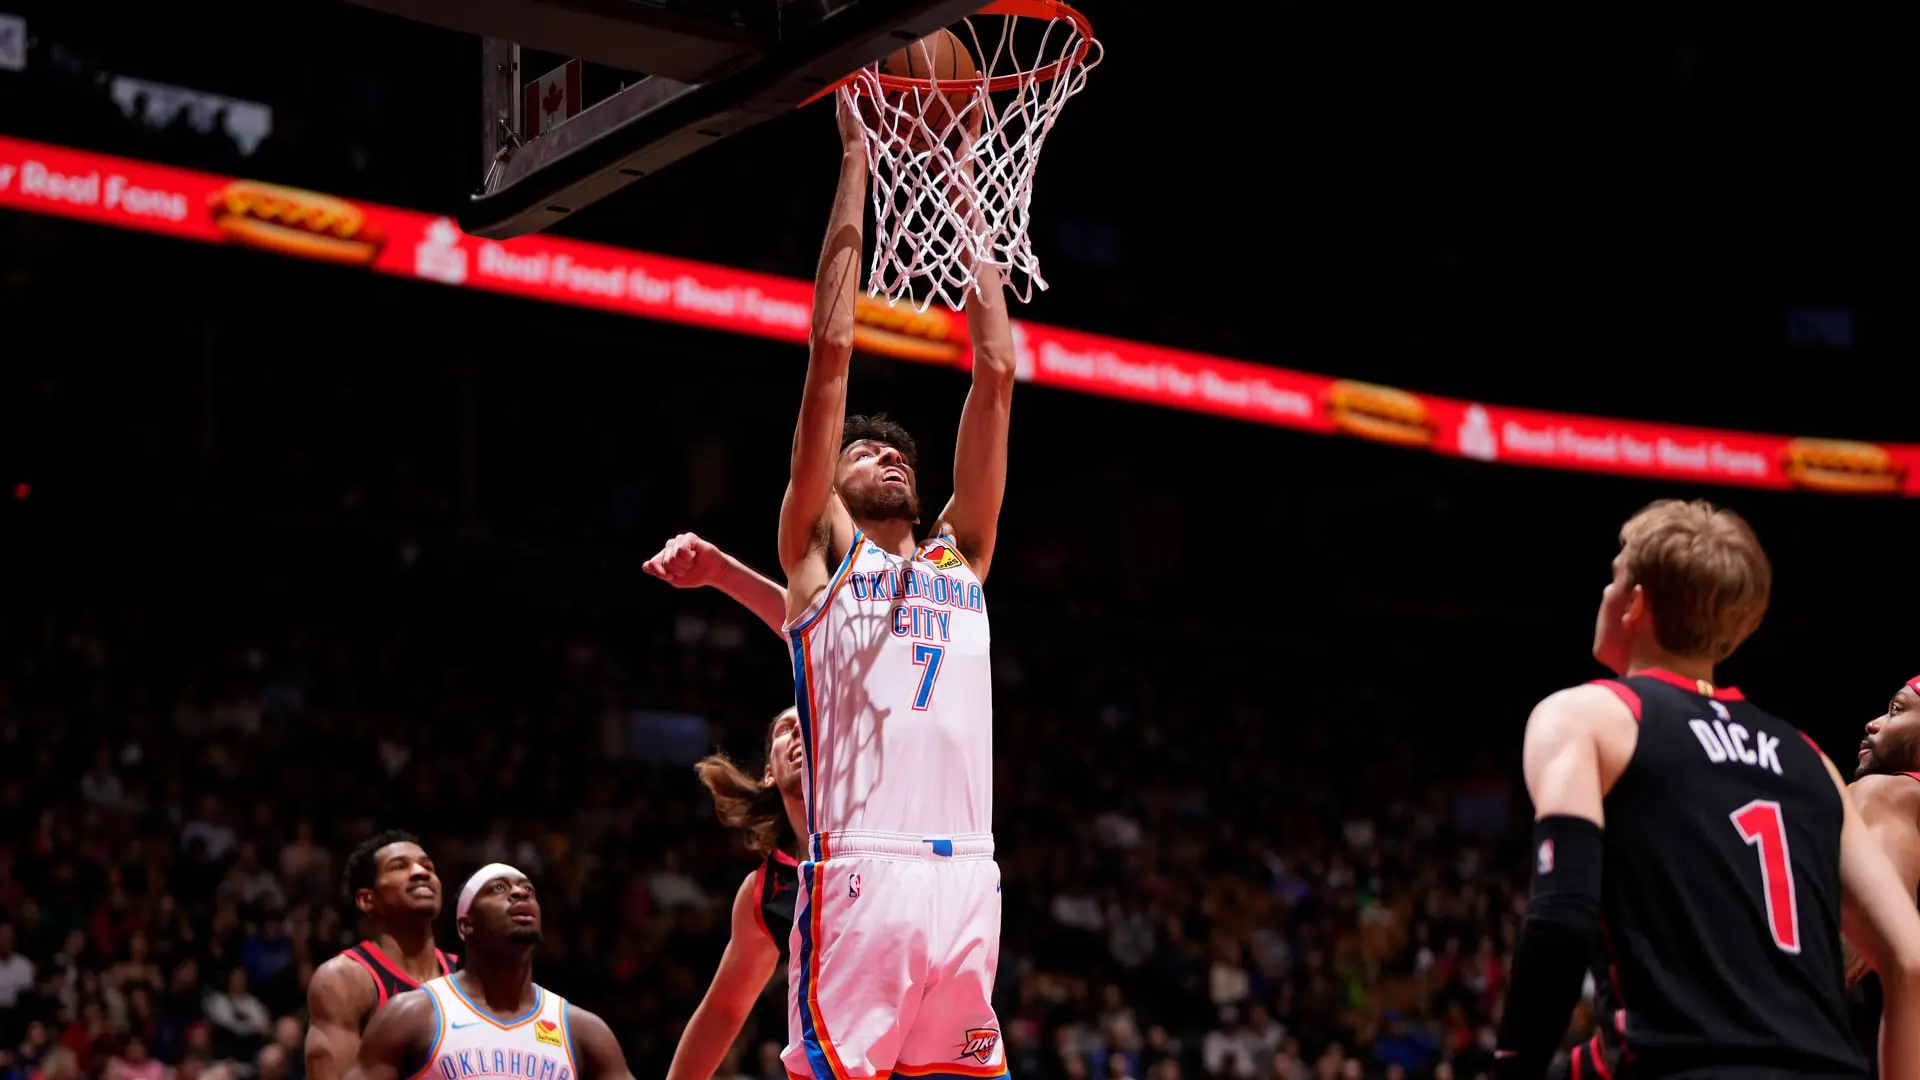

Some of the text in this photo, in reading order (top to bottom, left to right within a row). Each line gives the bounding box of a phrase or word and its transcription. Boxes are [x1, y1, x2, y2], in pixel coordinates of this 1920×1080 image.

[21, 159, 100, 206] Real
[104, 173, 188, 222] Fans
[477, 243, 811, 329] Real Food for Real Fans
[849, 568, 983, 613] OKLAHOMA
[891, 606, 951, 642] CITY
[912, 642, 945, 711] 7
[1688, 719, 1783, 775] DICK
[1730, 798, 1801, 954] 1
[438, 1047, 573, 1080] OKLAHOMA
